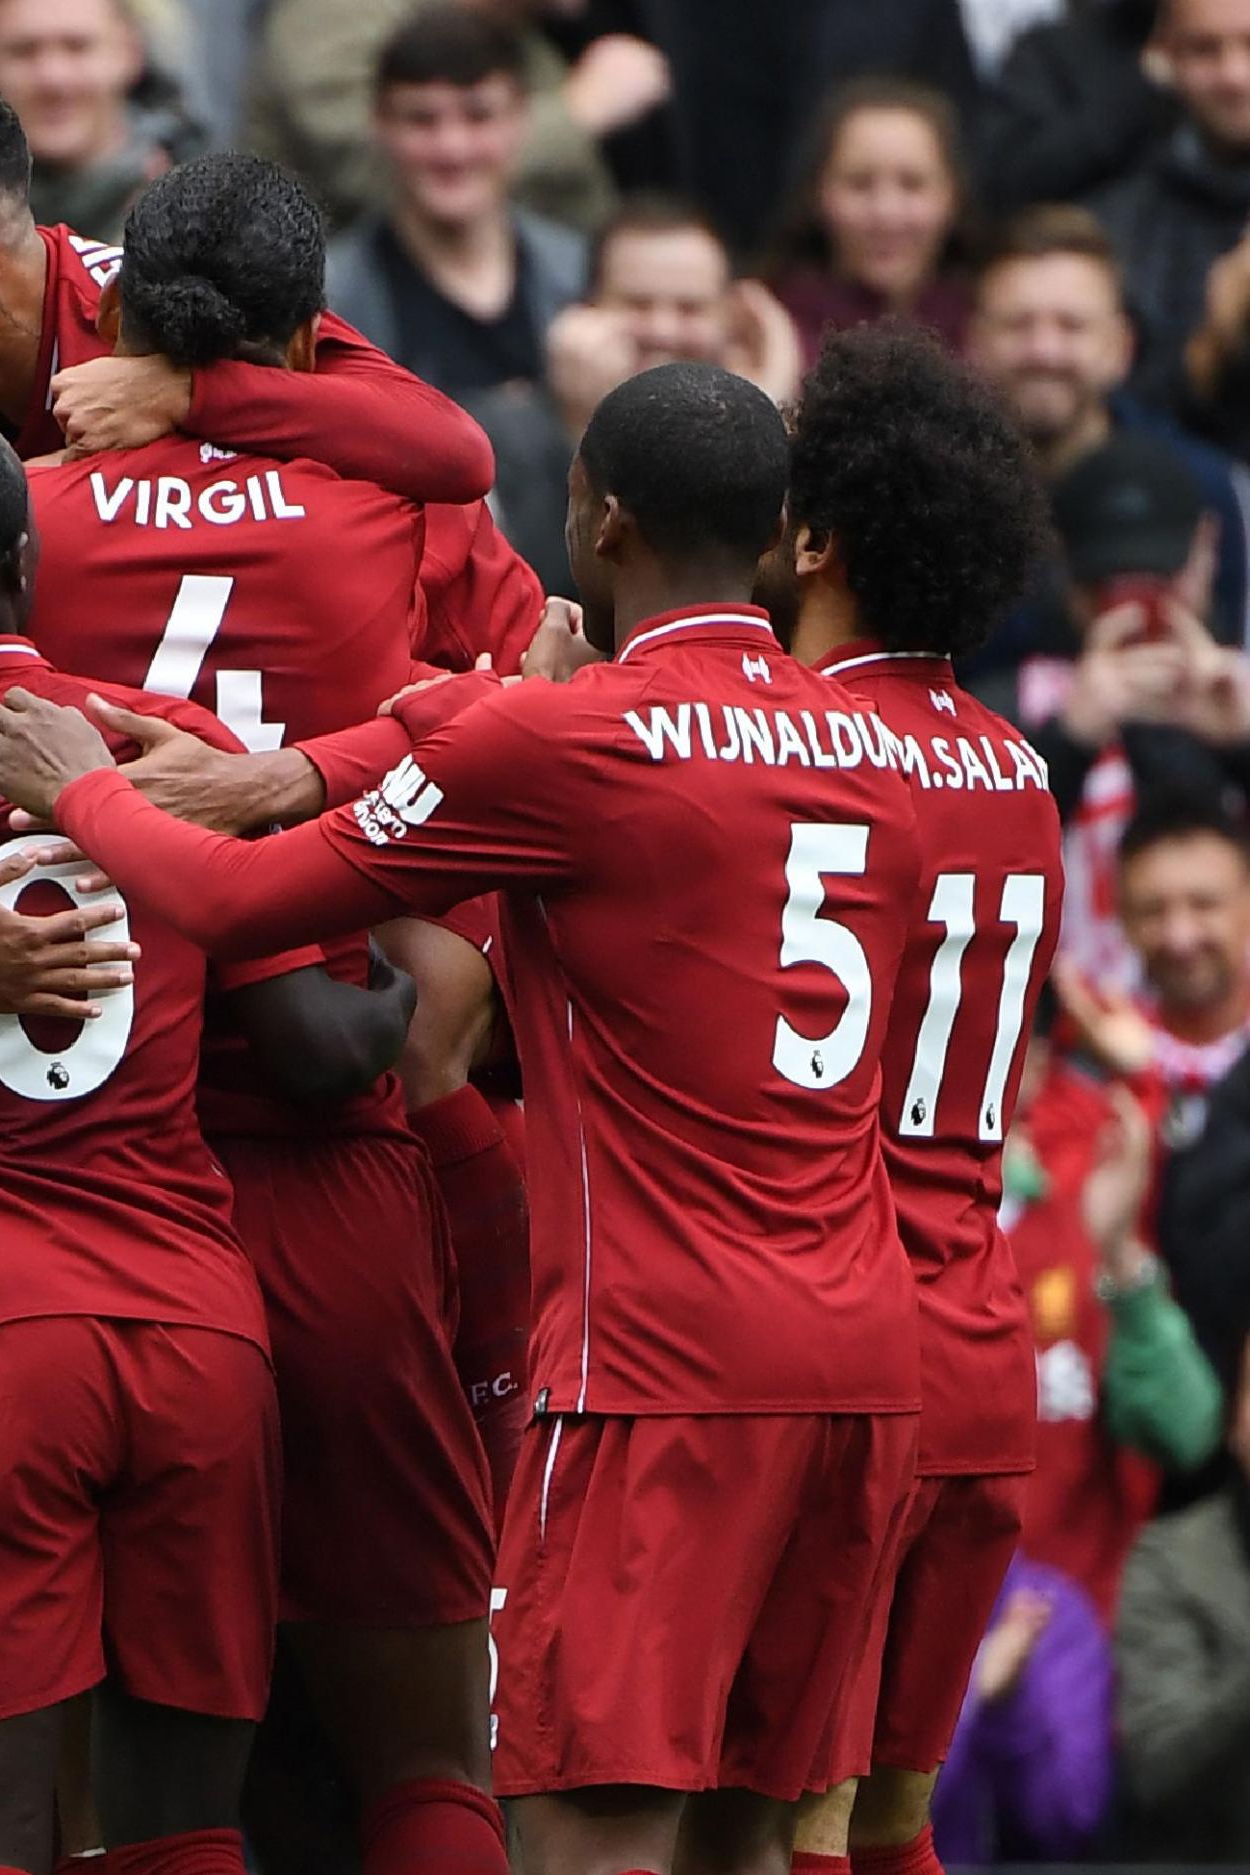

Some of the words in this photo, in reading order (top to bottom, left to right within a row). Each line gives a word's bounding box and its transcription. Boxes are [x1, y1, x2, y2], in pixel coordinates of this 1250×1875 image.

[89, 470, 306, 529] VIRGIL
[143, 574, 286, 755] 4
[770, 822, 872, 1090] 5
[899, 873, 1045, 1141] 11
